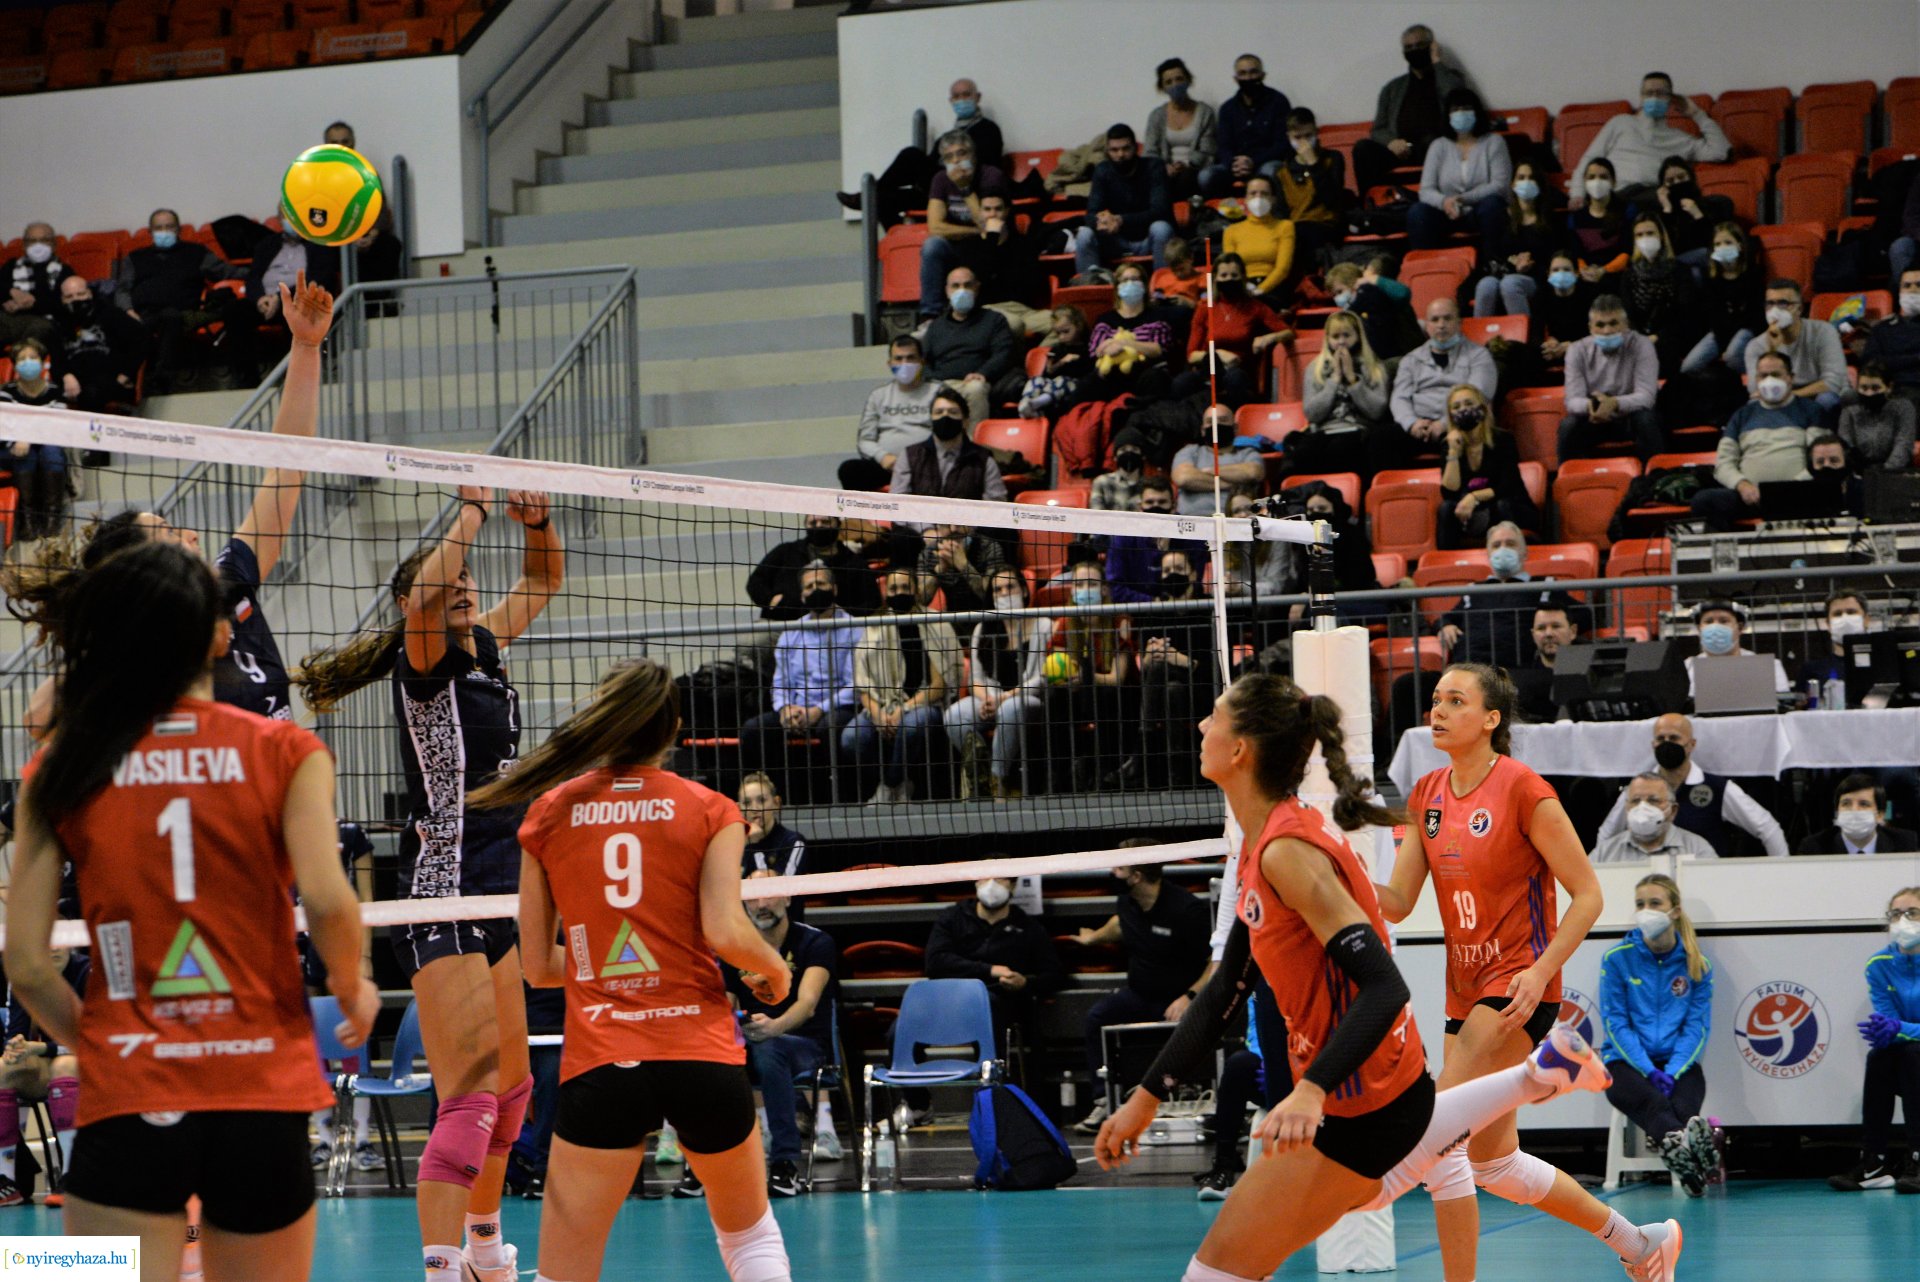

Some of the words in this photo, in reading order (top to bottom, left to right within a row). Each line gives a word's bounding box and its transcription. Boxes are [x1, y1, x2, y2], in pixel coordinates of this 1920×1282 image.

[113, 747, 246, 788] VASILEVA
[571, 798, 676, 828] BODOVICS
[157, 797, 196, 902] 1
[603, 832, 642, 909] 9
[1453, 890, 1477, 930] 19
[1756, 983, 1805, 998] FATUM
[611, 1005, 700, 1021] BESTRONG
[153, 1037, 275, 1059] BESTRONG
